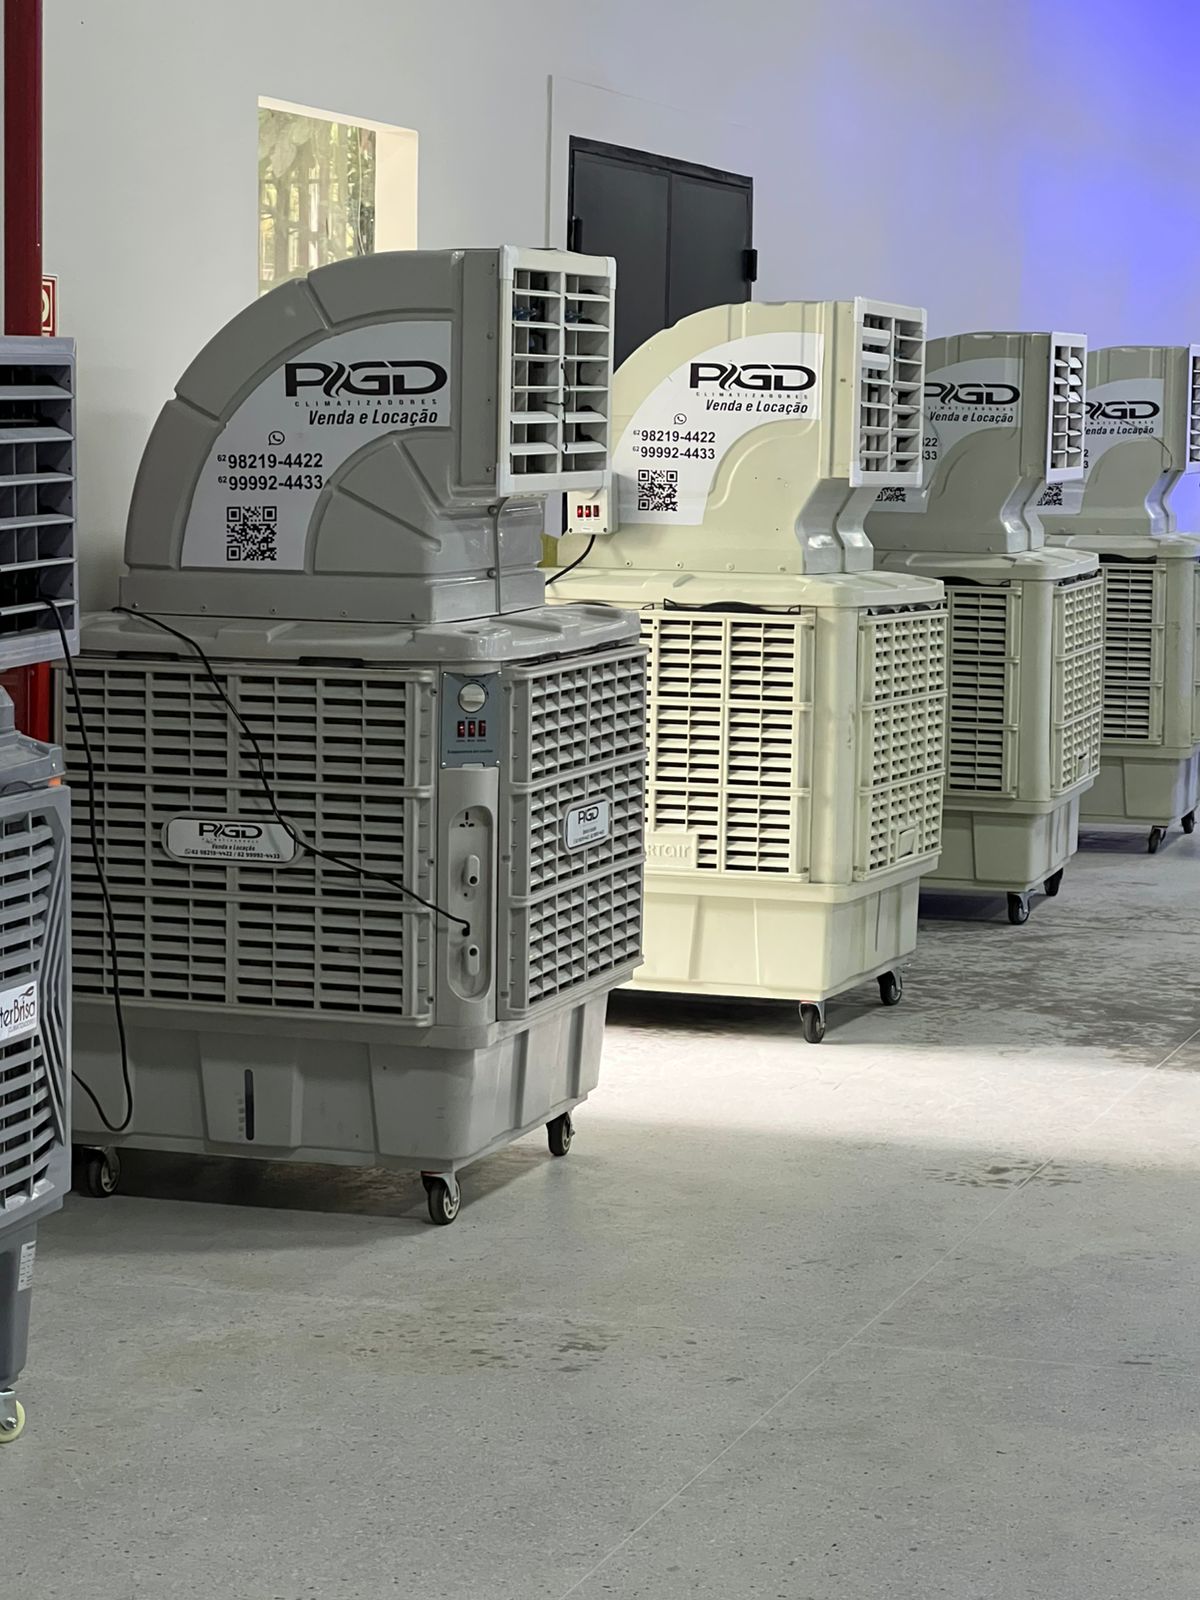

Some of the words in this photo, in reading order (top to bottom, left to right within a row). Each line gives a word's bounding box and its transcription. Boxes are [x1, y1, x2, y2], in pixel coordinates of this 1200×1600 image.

[295, 398, 437, 407] CLIMATIZADORES
[706, 400, 742, 412] Venda
[746, 403, 753, 412] e
[756, 401, 808, 415] Locação
[309, 410, 354, 426] Venda
[359, 412, 368, 424] e
[372, 409, 438, 427] Locação
[930, 411, 959, 422] Venda
[962, 414, 968, 422] e
[971, 412, 1014, 424] Locação
[641, 430, 716, 443] 98219-4422
[1084, 427, 1107, 435] enda
[641, 447, 715, 459] 99992-4433
[217, 454, 227, 462] 62
[228, 453, 323, 469] 98219-4422
[218, 476, 227, 484] 62
[229, 475, 323, 490] 99992-4433
